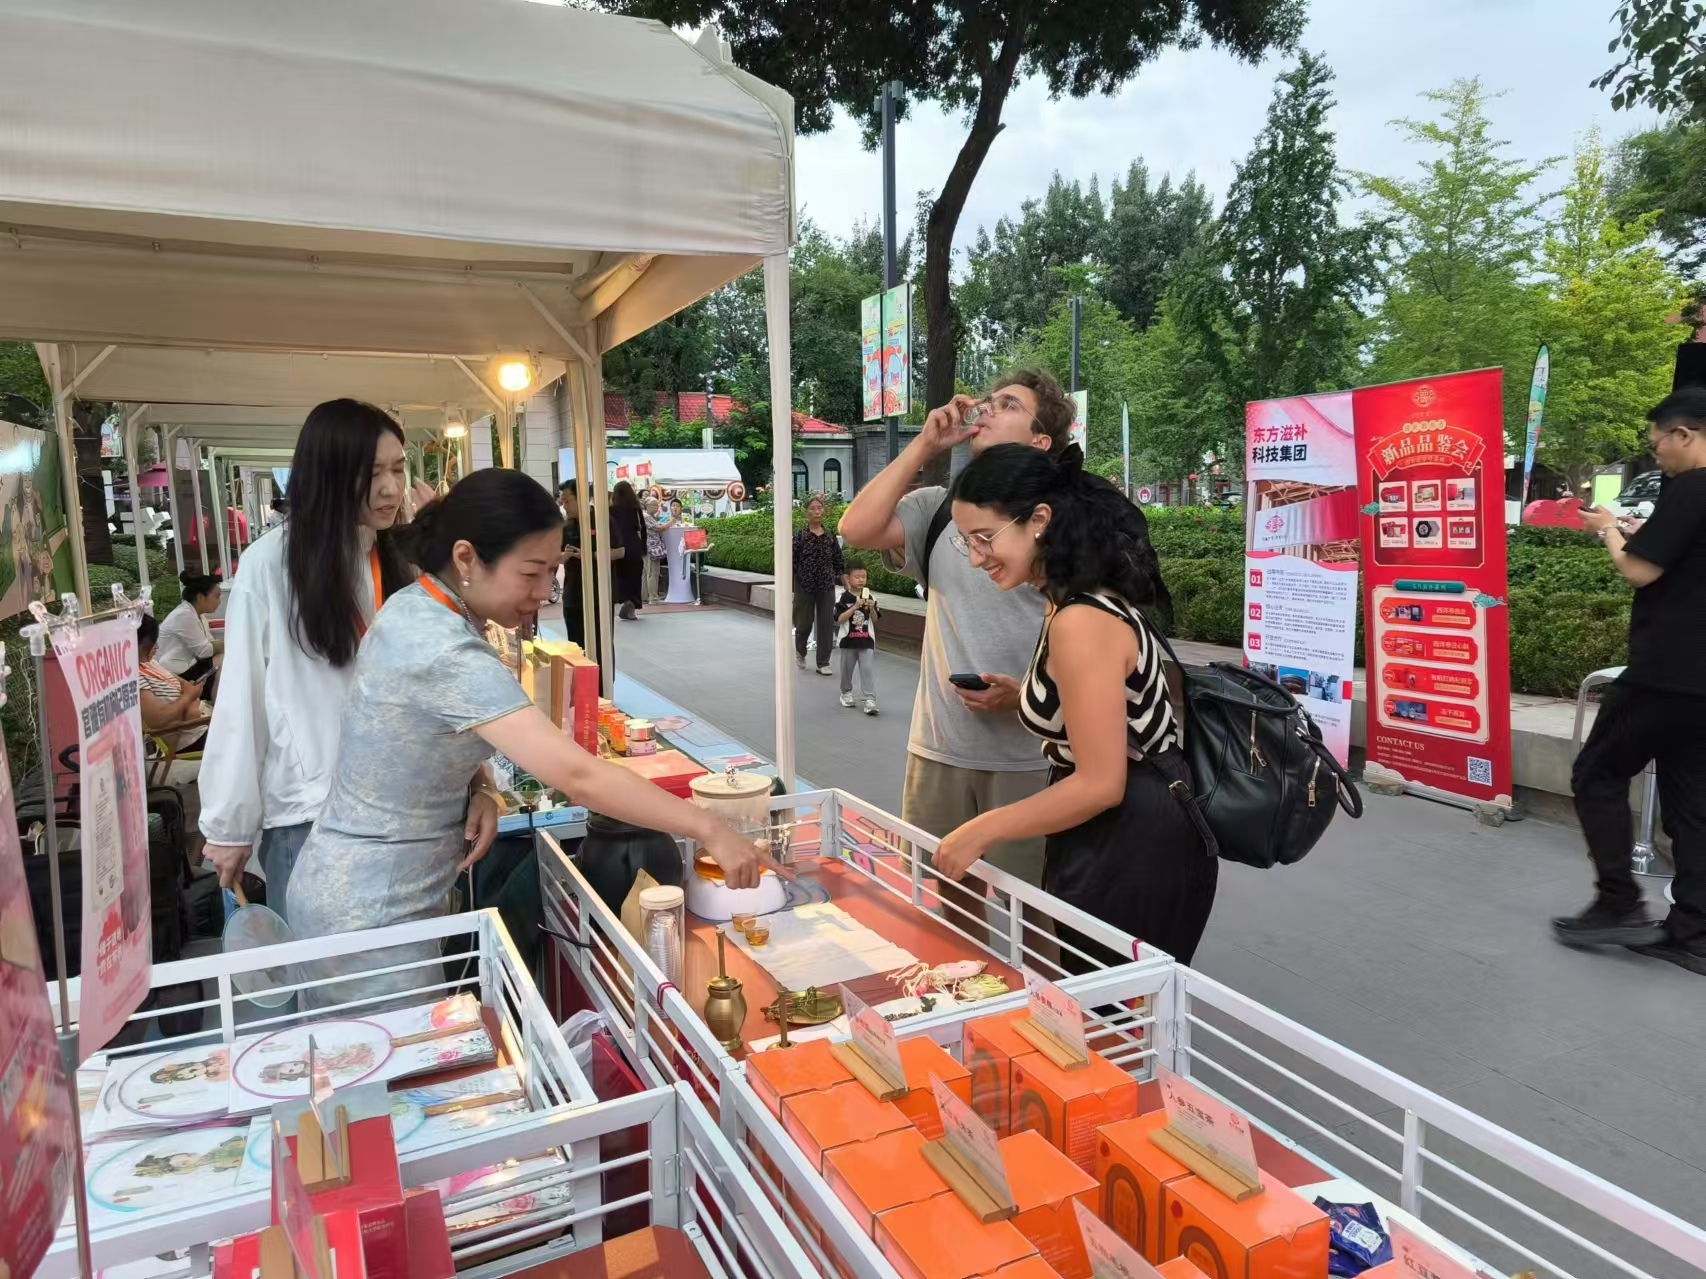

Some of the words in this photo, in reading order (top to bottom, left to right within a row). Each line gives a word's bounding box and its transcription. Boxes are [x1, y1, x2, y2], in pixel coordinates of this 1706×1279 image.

[1253, 423, 1308, 443] 东方滋补
[1252, 444, 1307, 463] 科技集团
[1381, 434, 1470, 466] 新品品鉴会
[1251, 574, 1262, 584] 01
[1250, 608, 1262, 617] 02
[1250, 637, 1261, 647] 03
[76, 639, 133, 699] ORGANIC
[1376, 735, 1412, 749] CONTACT
[1414, 742, 1425, 751] US
[1169, 1091, 1215, 1126] 人参五宝茶
